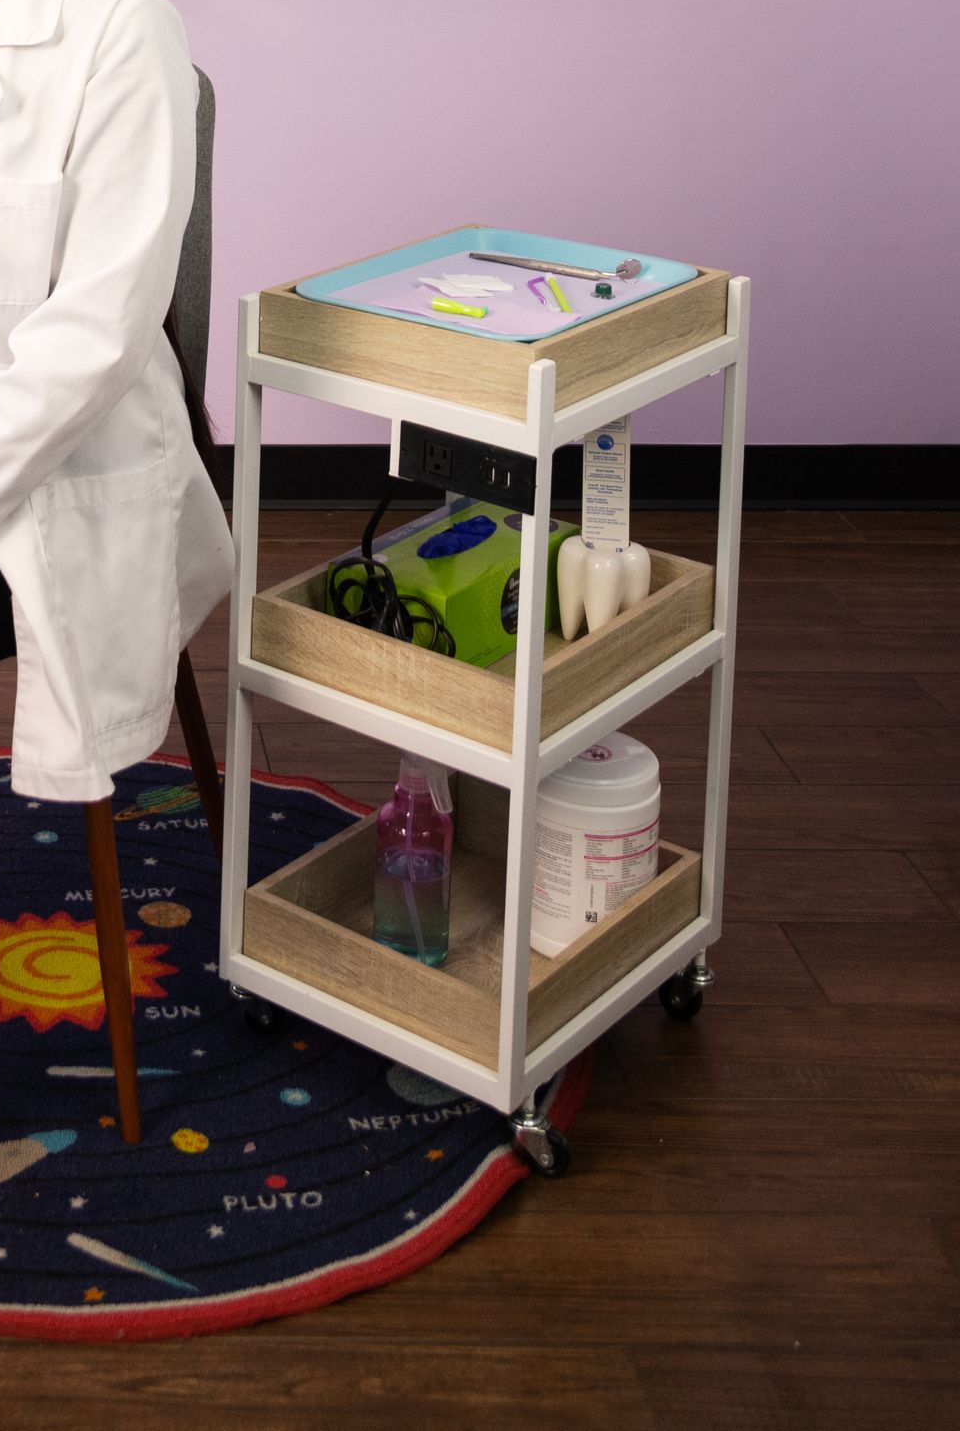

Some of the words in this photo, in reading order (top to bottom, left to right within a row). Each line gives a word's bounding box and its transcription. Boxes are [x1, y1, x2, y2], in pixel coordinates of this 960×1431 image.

[136, 817, 209, 831] SATUR
[64, 886, 176, 902] MECURY
[144, 1005, 201, 1021] SUN
[348, 1101, 481, 1131] NEPTUNE
[222, 1190, 323, 1213] PLUTO
